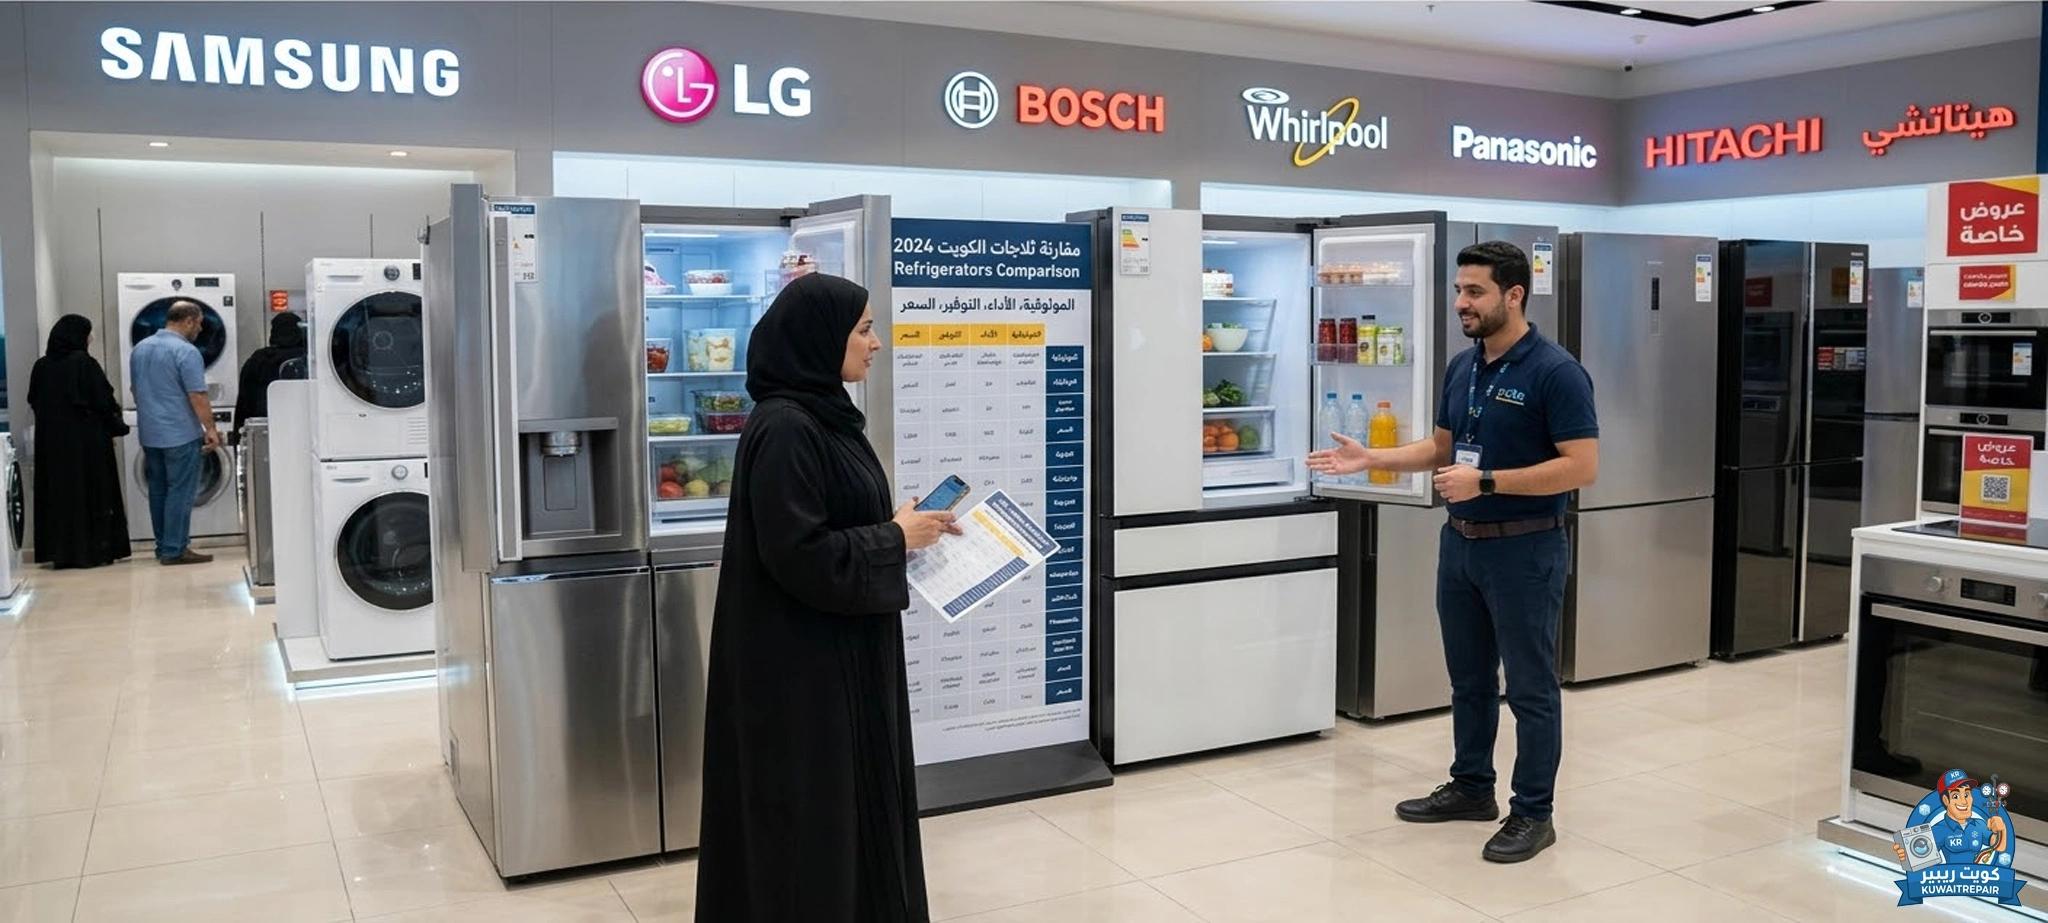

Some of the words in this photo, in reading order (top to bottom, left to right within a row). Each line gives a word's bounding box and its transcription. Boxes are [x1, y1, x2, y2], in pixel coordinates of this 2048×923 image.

[100, 26, 460, 97] SAMSUNG
[733, 63, 812, 118] LG
[1017, 84, 1165, 132] BOSCH
[1247, 104, 1388, 155] Whirlpool
[1862, 103, 2016, 155] هيتاتشي
[1452, 125, 1598, 169] Panasonic
[1645, 117, 1824, 169] HITACHI
[1960, 202, 2025, 221] عروض
[1960, 225, 2024, 243] خاصة
[893, 237, 934, 253] 2024
[938, 239, 986, 258] الكويت
[990, 239, 1036, 258] ثلاجات
[1039, 240, 1081, 260] مقارنة
[893, 260, 993, 279] Refrigerators
[996, 262, 1080, 280] Comparison
[900, 297, 935, 313] السعر
